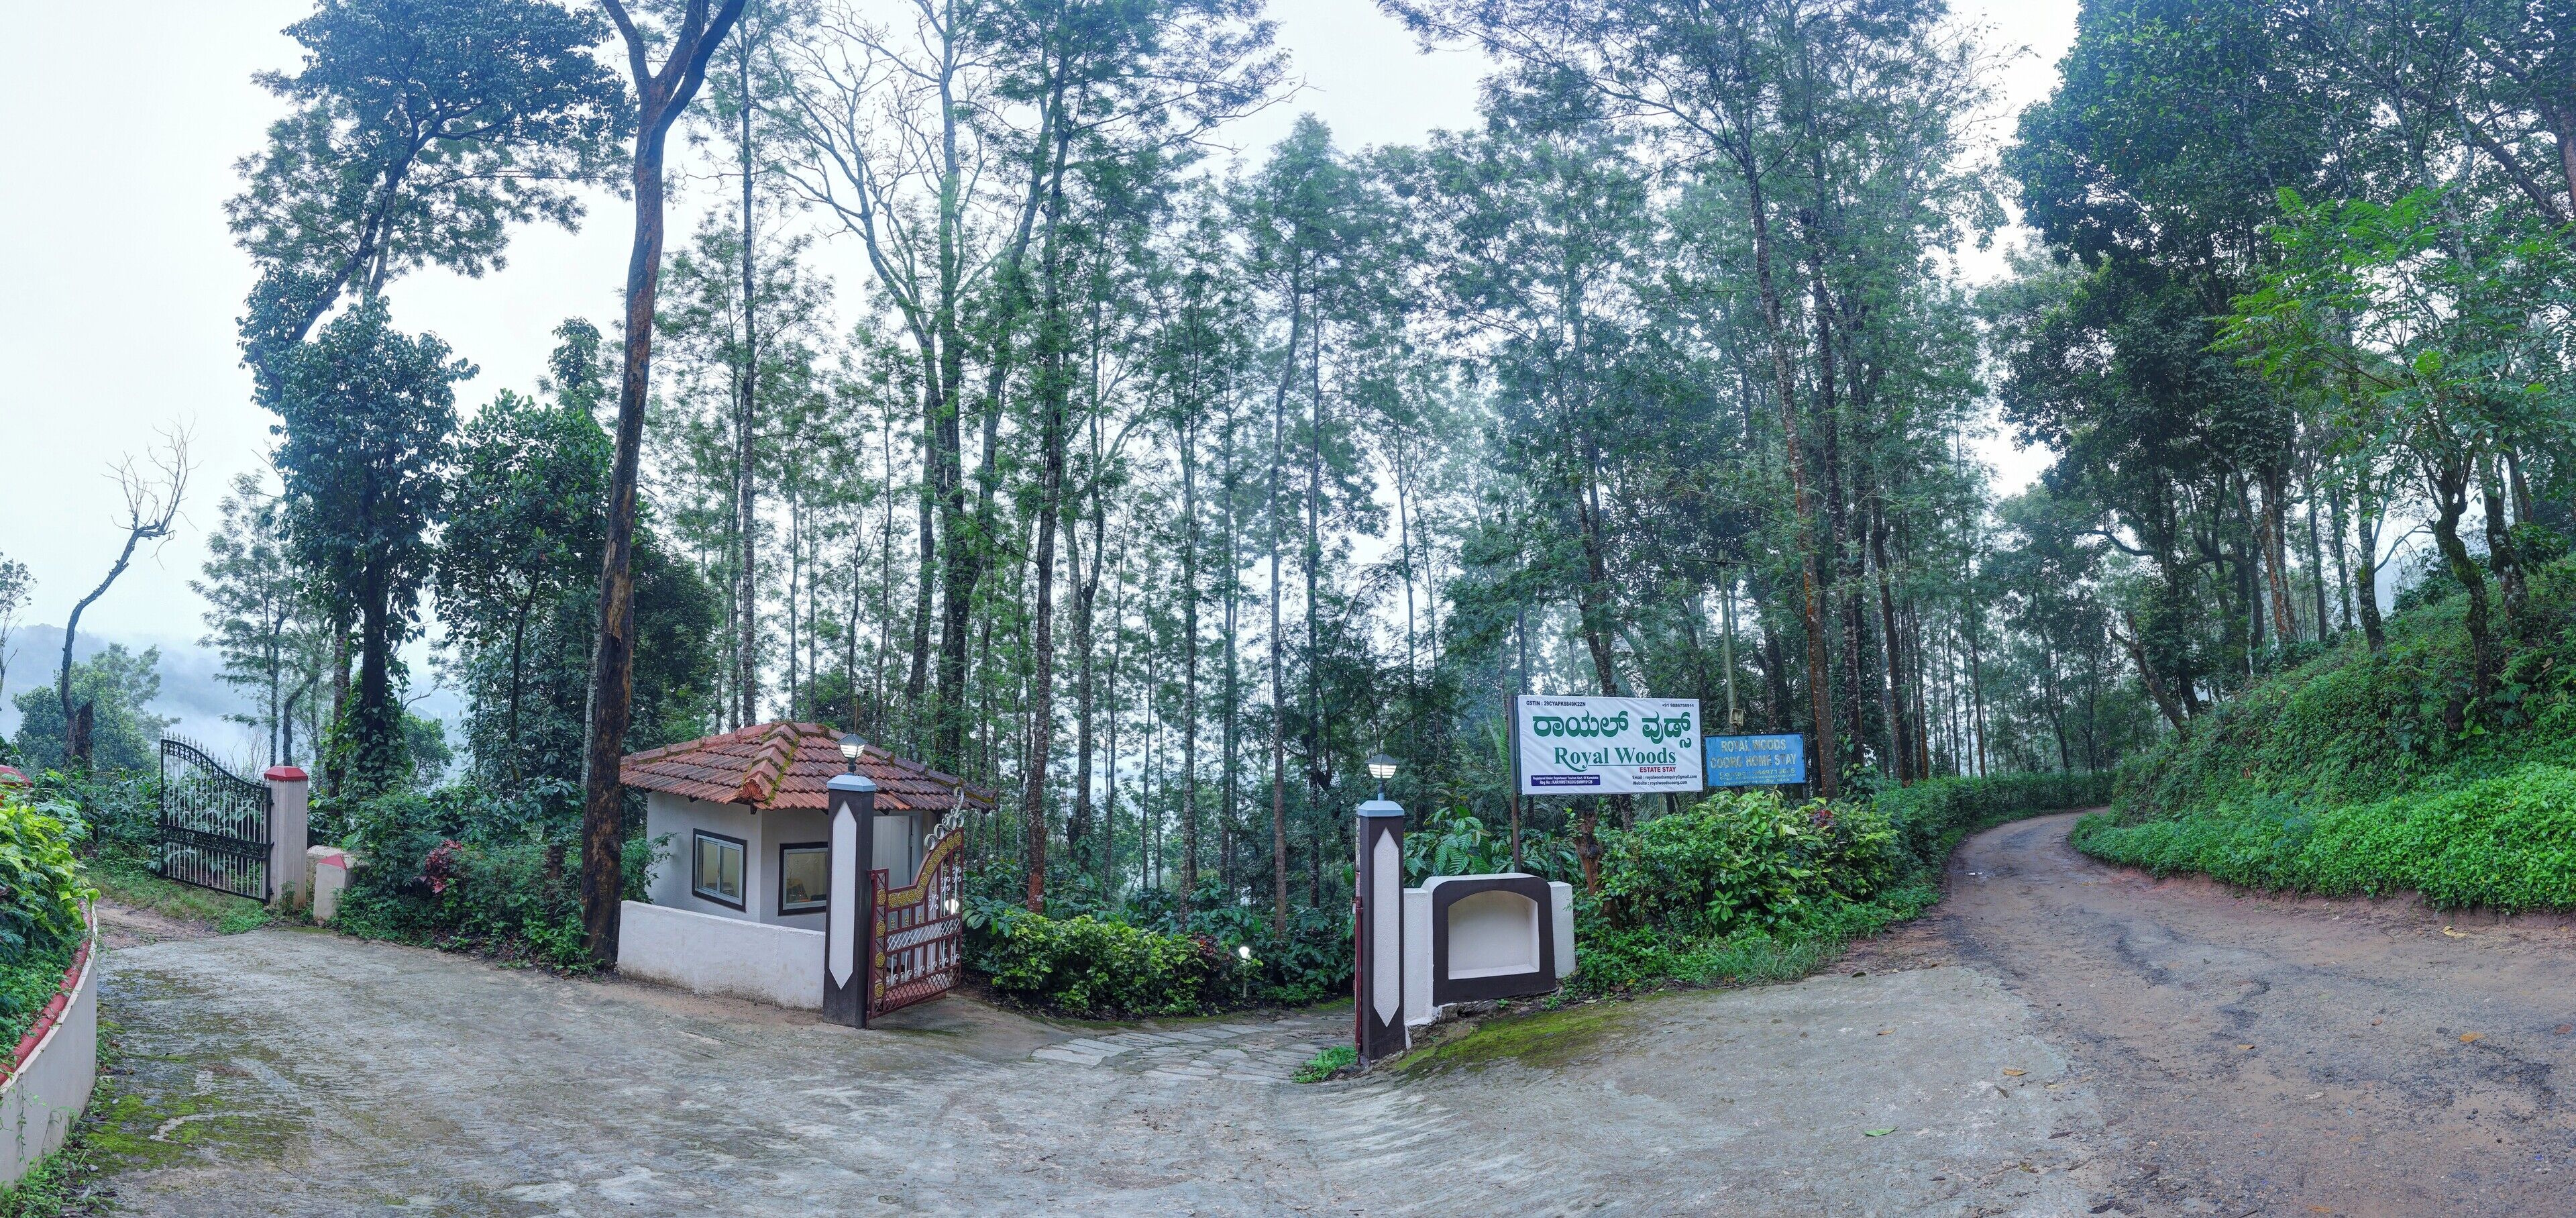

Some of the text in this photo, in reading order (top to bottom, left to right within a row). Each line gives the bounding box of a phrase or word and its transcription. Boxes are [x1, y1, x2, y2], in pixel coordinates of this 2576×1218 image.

[1533, 709, 1692, 748] ರಾಯಲ್ ವುಡ್ಸ್
[1721, 738, 1786, 752] ROYAL WOODS
[1554, 747, 1676, 772] Royal Woods
[1710, 753, 1796, 769] COORG HOME STAY
